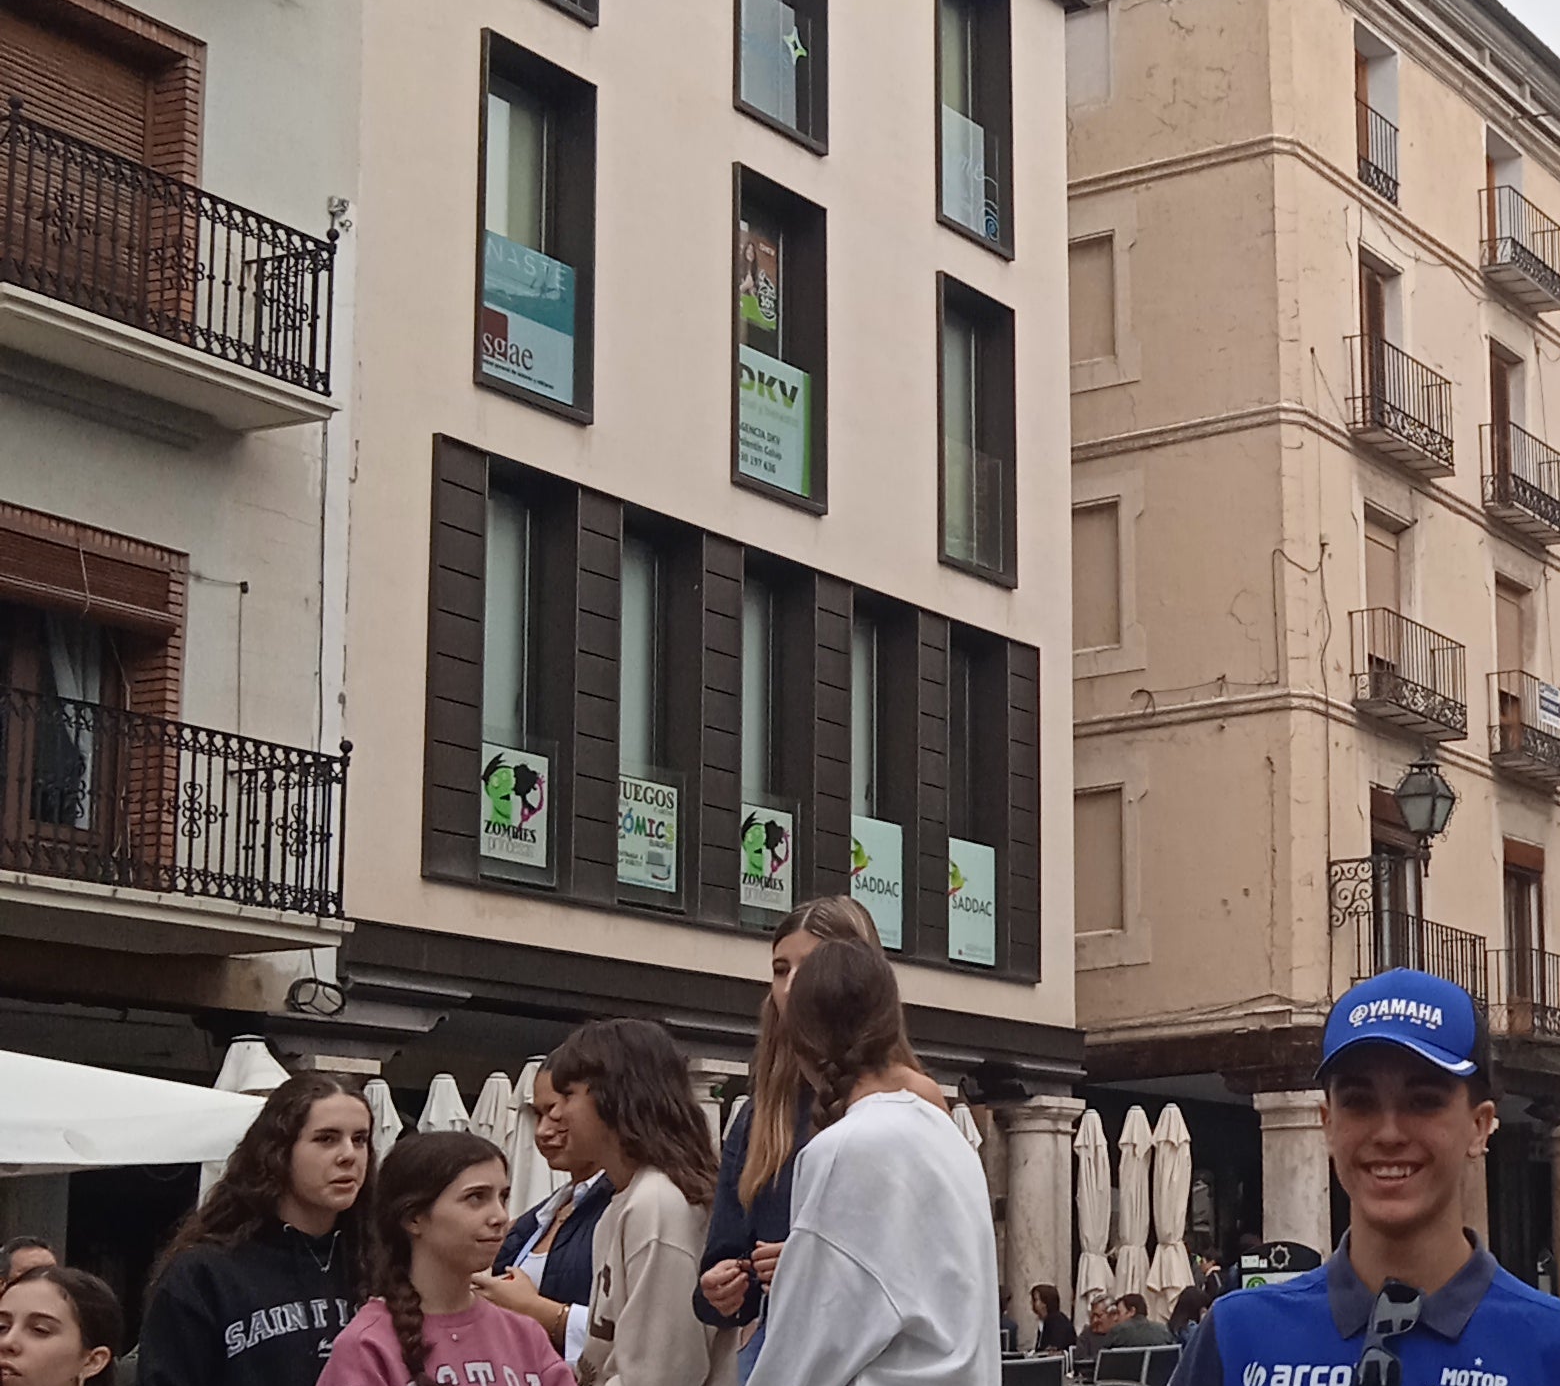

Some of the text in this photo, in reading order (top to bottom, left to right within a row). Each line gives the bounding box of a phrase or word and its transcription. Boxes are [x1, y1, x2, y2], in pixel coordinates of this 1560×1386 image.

[482, 332, 533, 370] sgae
[740, 362, 799, 409] DKV
[740, 422, 765, 439] GENCIA
[619, 781, 674, 810] UEGOS
[484, 819, 537, 844] ZOMBIES
[741, 872, 785, 892] ZOMBIES
[854, 874, 900, 898] SADDAC
[952, 894, 992, 917] SADDAC
[1369, 998, 1443, 1026] YAMAHA
[225, 1299, 329, 1359] SAINT
